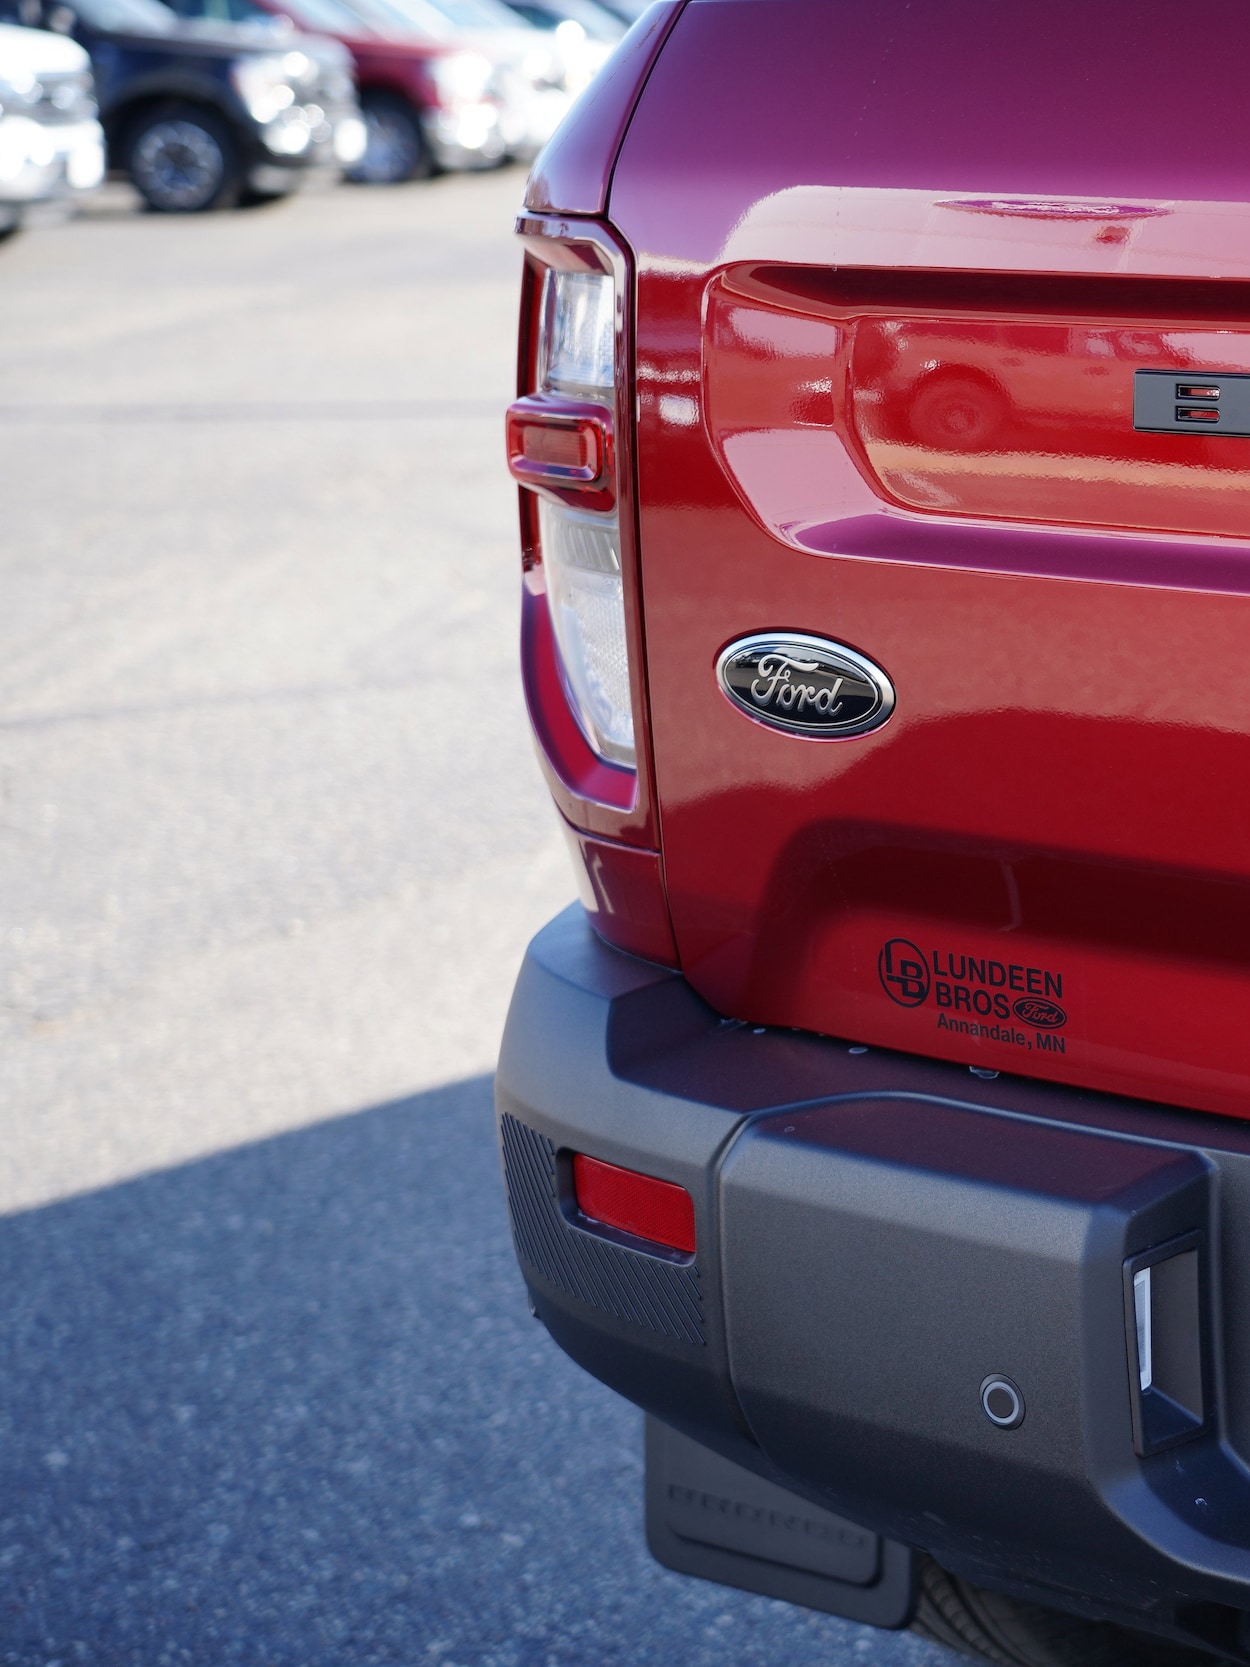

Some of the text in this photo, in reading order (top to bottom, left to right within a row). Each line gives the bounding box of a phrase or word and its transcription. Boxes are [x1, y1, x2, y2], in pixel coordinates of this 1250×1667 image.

[750, 653, 844, 717] Ford
[932, 950, 1064, 999] LUNDEEN
[934, 981, 1011, 1020] BROS
[1020, 1000, 1059, 1025] Ford
[936, 1012, 1067, 1055] Annandale, MN
